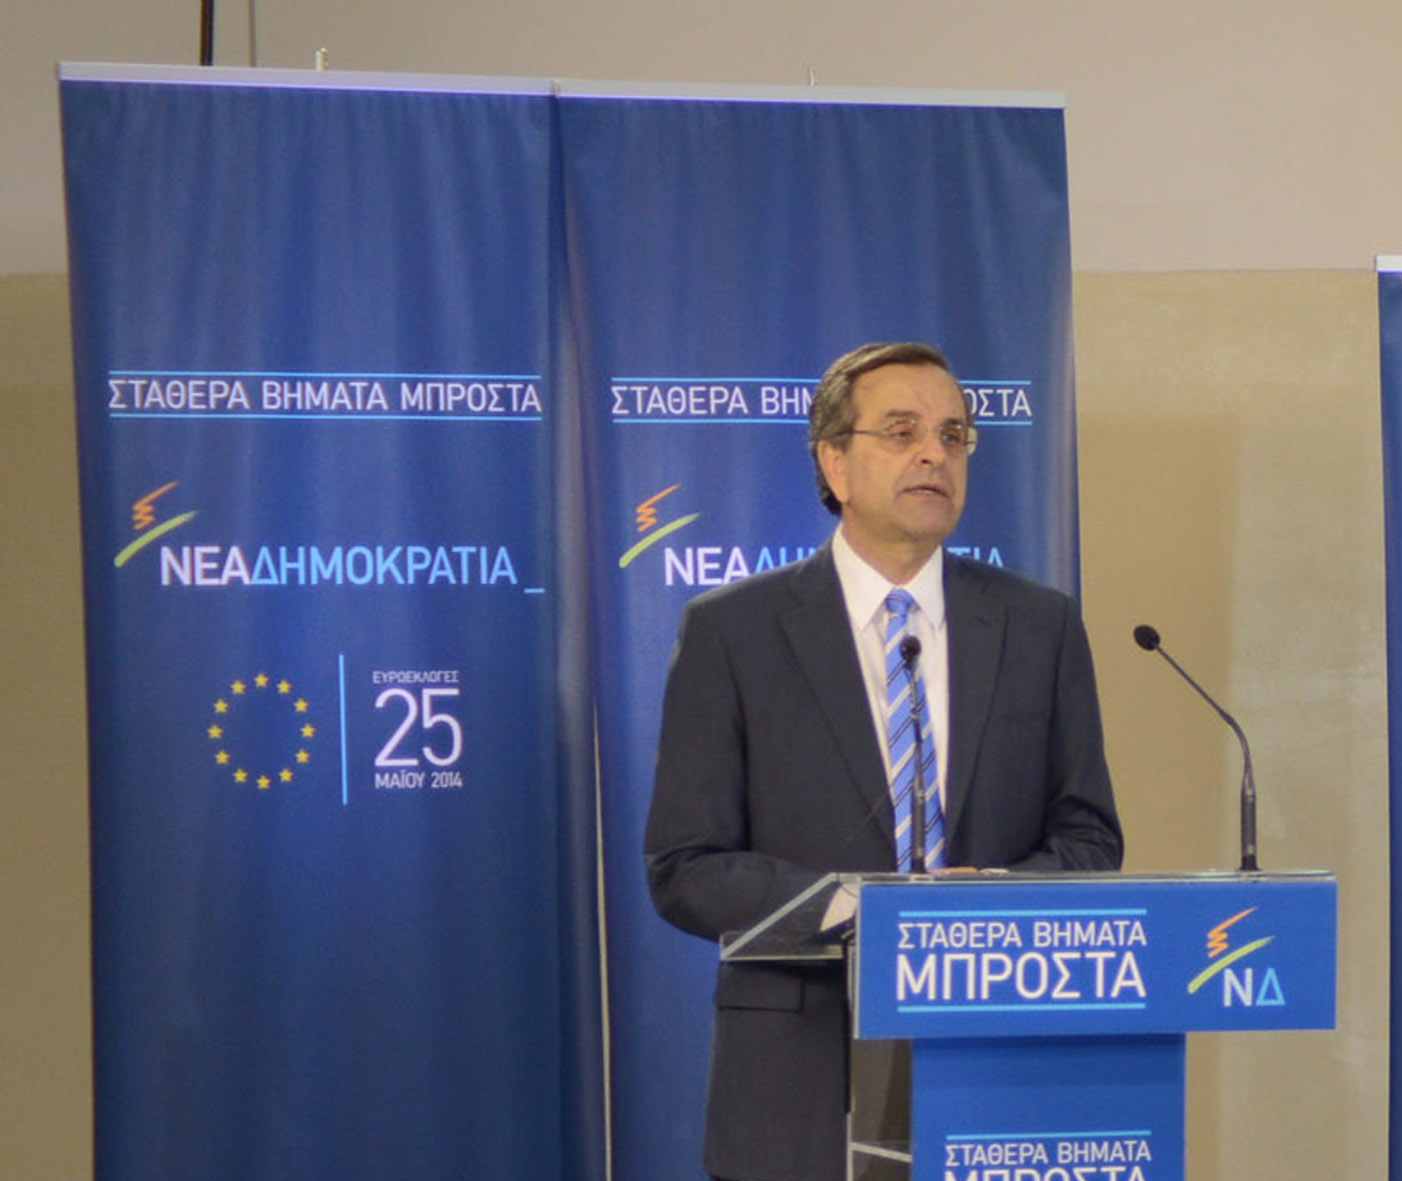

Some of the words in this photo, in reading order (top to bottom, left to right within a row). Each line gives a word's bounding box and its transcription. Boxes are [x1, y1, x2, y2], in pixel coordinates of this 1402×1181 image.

[108, 379, 250, 410] ΣΤΑΘΕΡΑ
[262, 380, 388, 411] ΒΗΜΑΤΑ
[401, 381, 542, 412] ΜΠΡΟΣΤΑ
[611, 385, 749, 415] ΣΤΑΘΕΡΑ
[372, 670, 459, 684] ΕΥΡΩΕΚΛΟΓΕΣ
[374, 687, 463, 767] 25
[431, 772, 463, 788] 2014
[897, 922, 1022, 950] ΣΤΑΘΕΡΑ
[1033, 920, 1148, 948] ΒΗΜΑΤΑ
[897, 950, 1147, 1001] ΜΠΡΟΣΤΑ
[1223, 967, 1286, 1007] ΝΔ
[944, 1143, 1049, 1167] ΣΤΑΘΕΡΑ
[1057, 1140, 1152, 1165] ΒΗΜΑΤΑ
